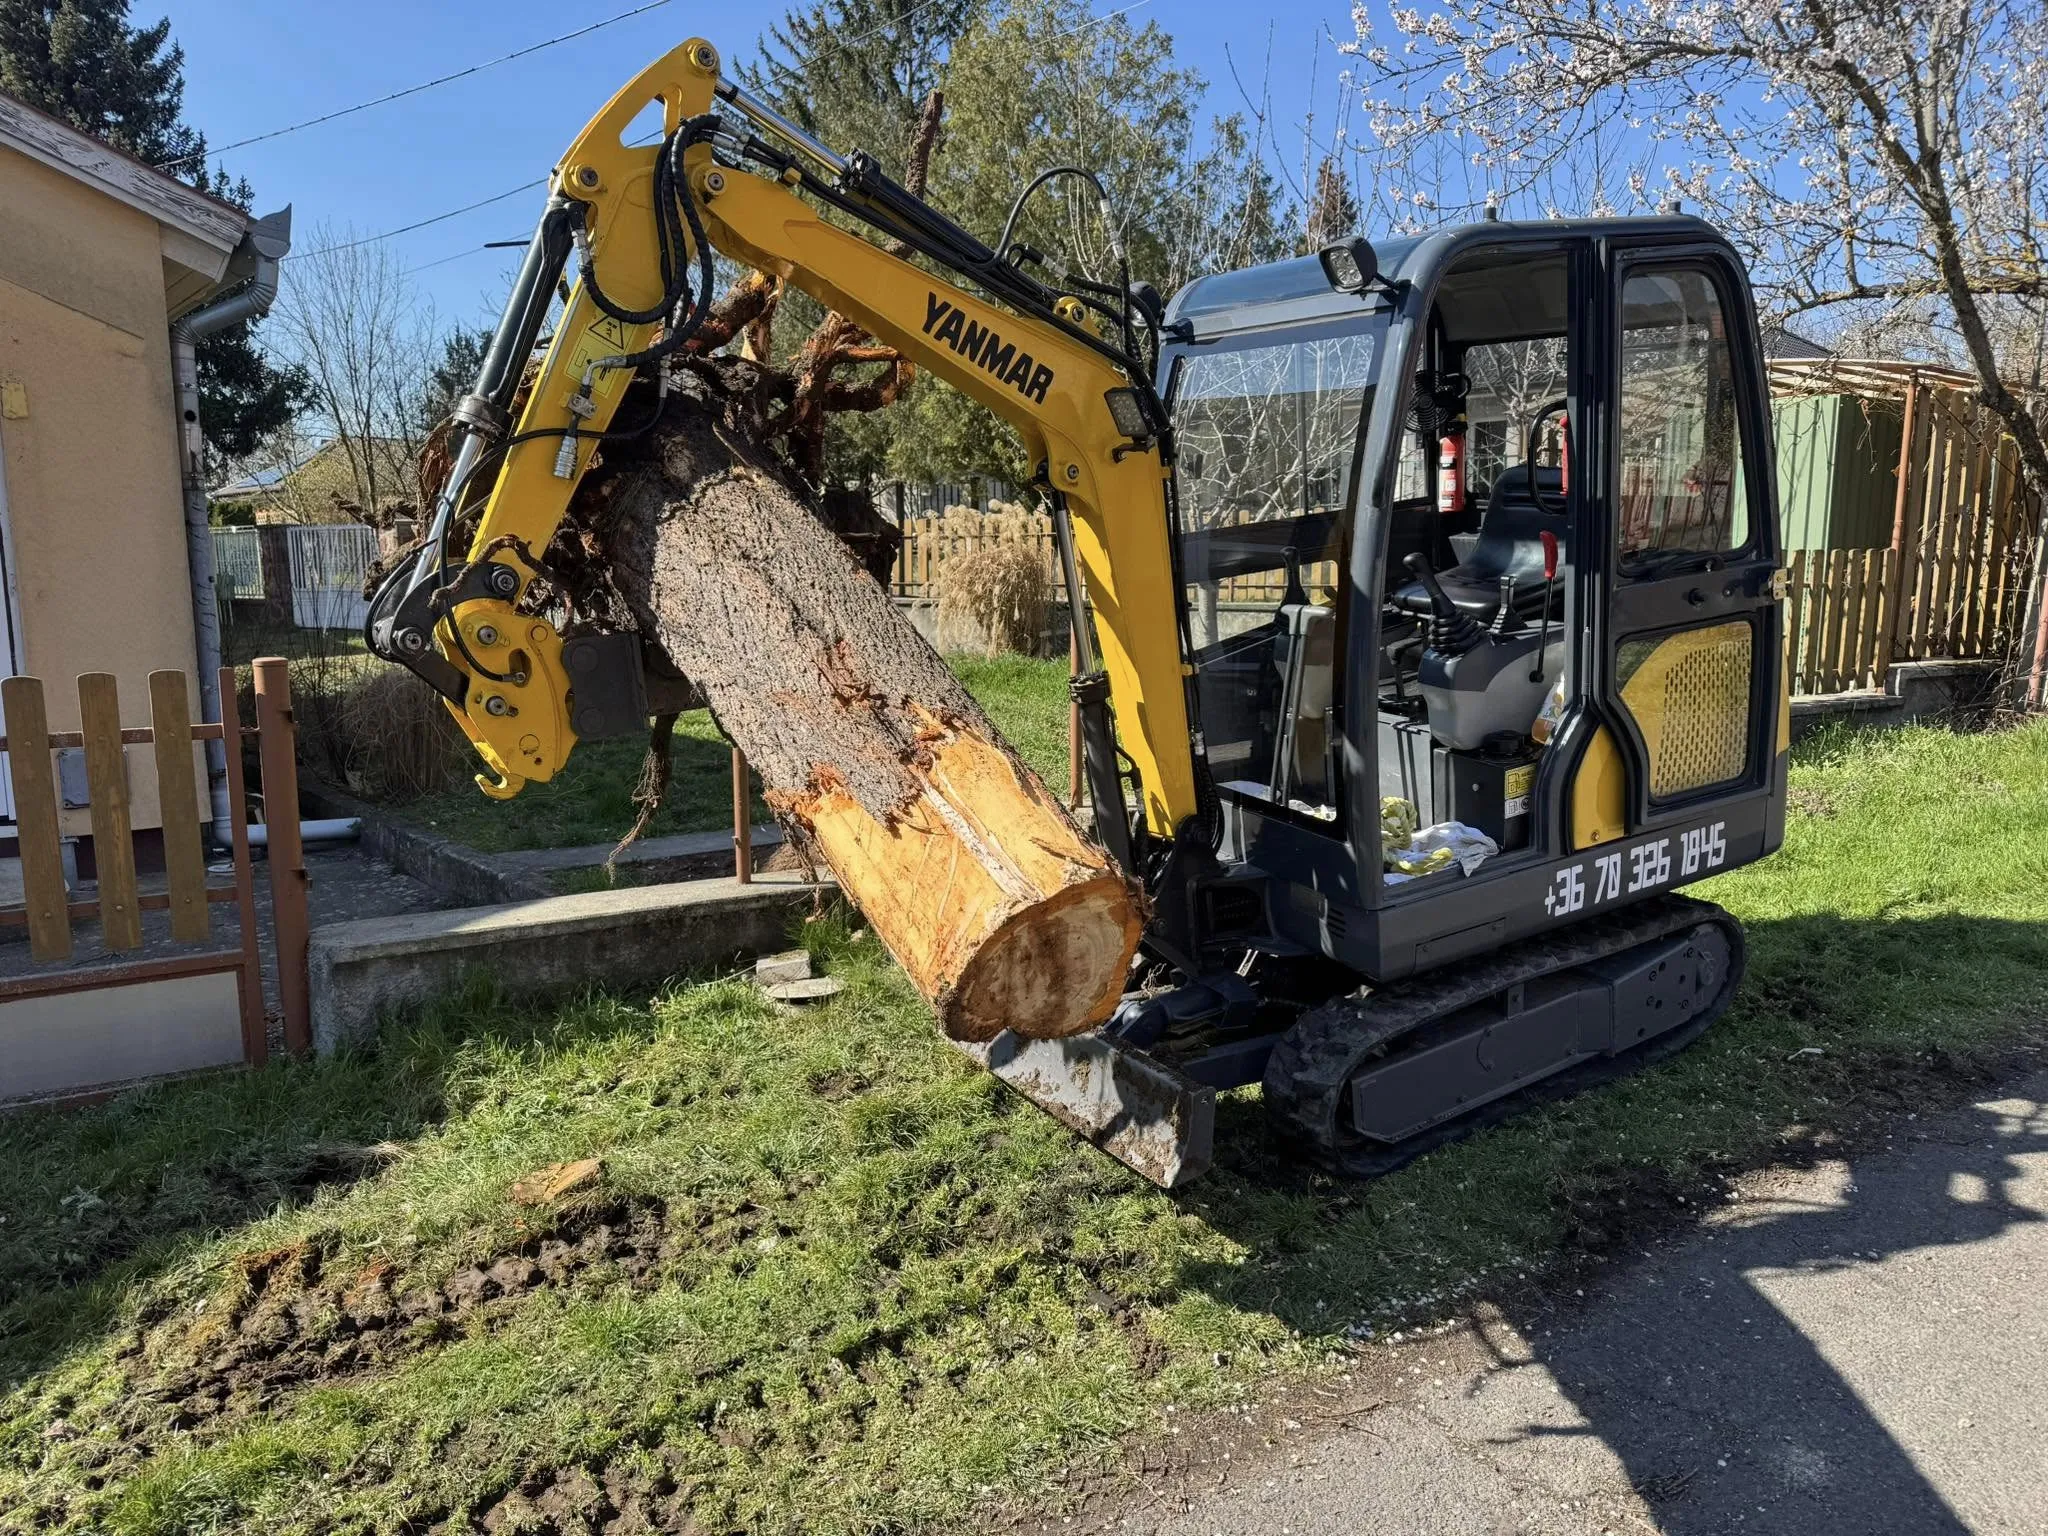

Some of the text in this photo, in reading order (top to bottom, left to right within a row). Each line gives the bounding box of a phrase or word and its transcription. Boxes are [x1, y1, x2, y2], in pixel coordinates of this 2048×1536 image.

[922, 291, 1054, 404] YANMAR
[1544, 821, 1726, 917] +36 70 326 1845
